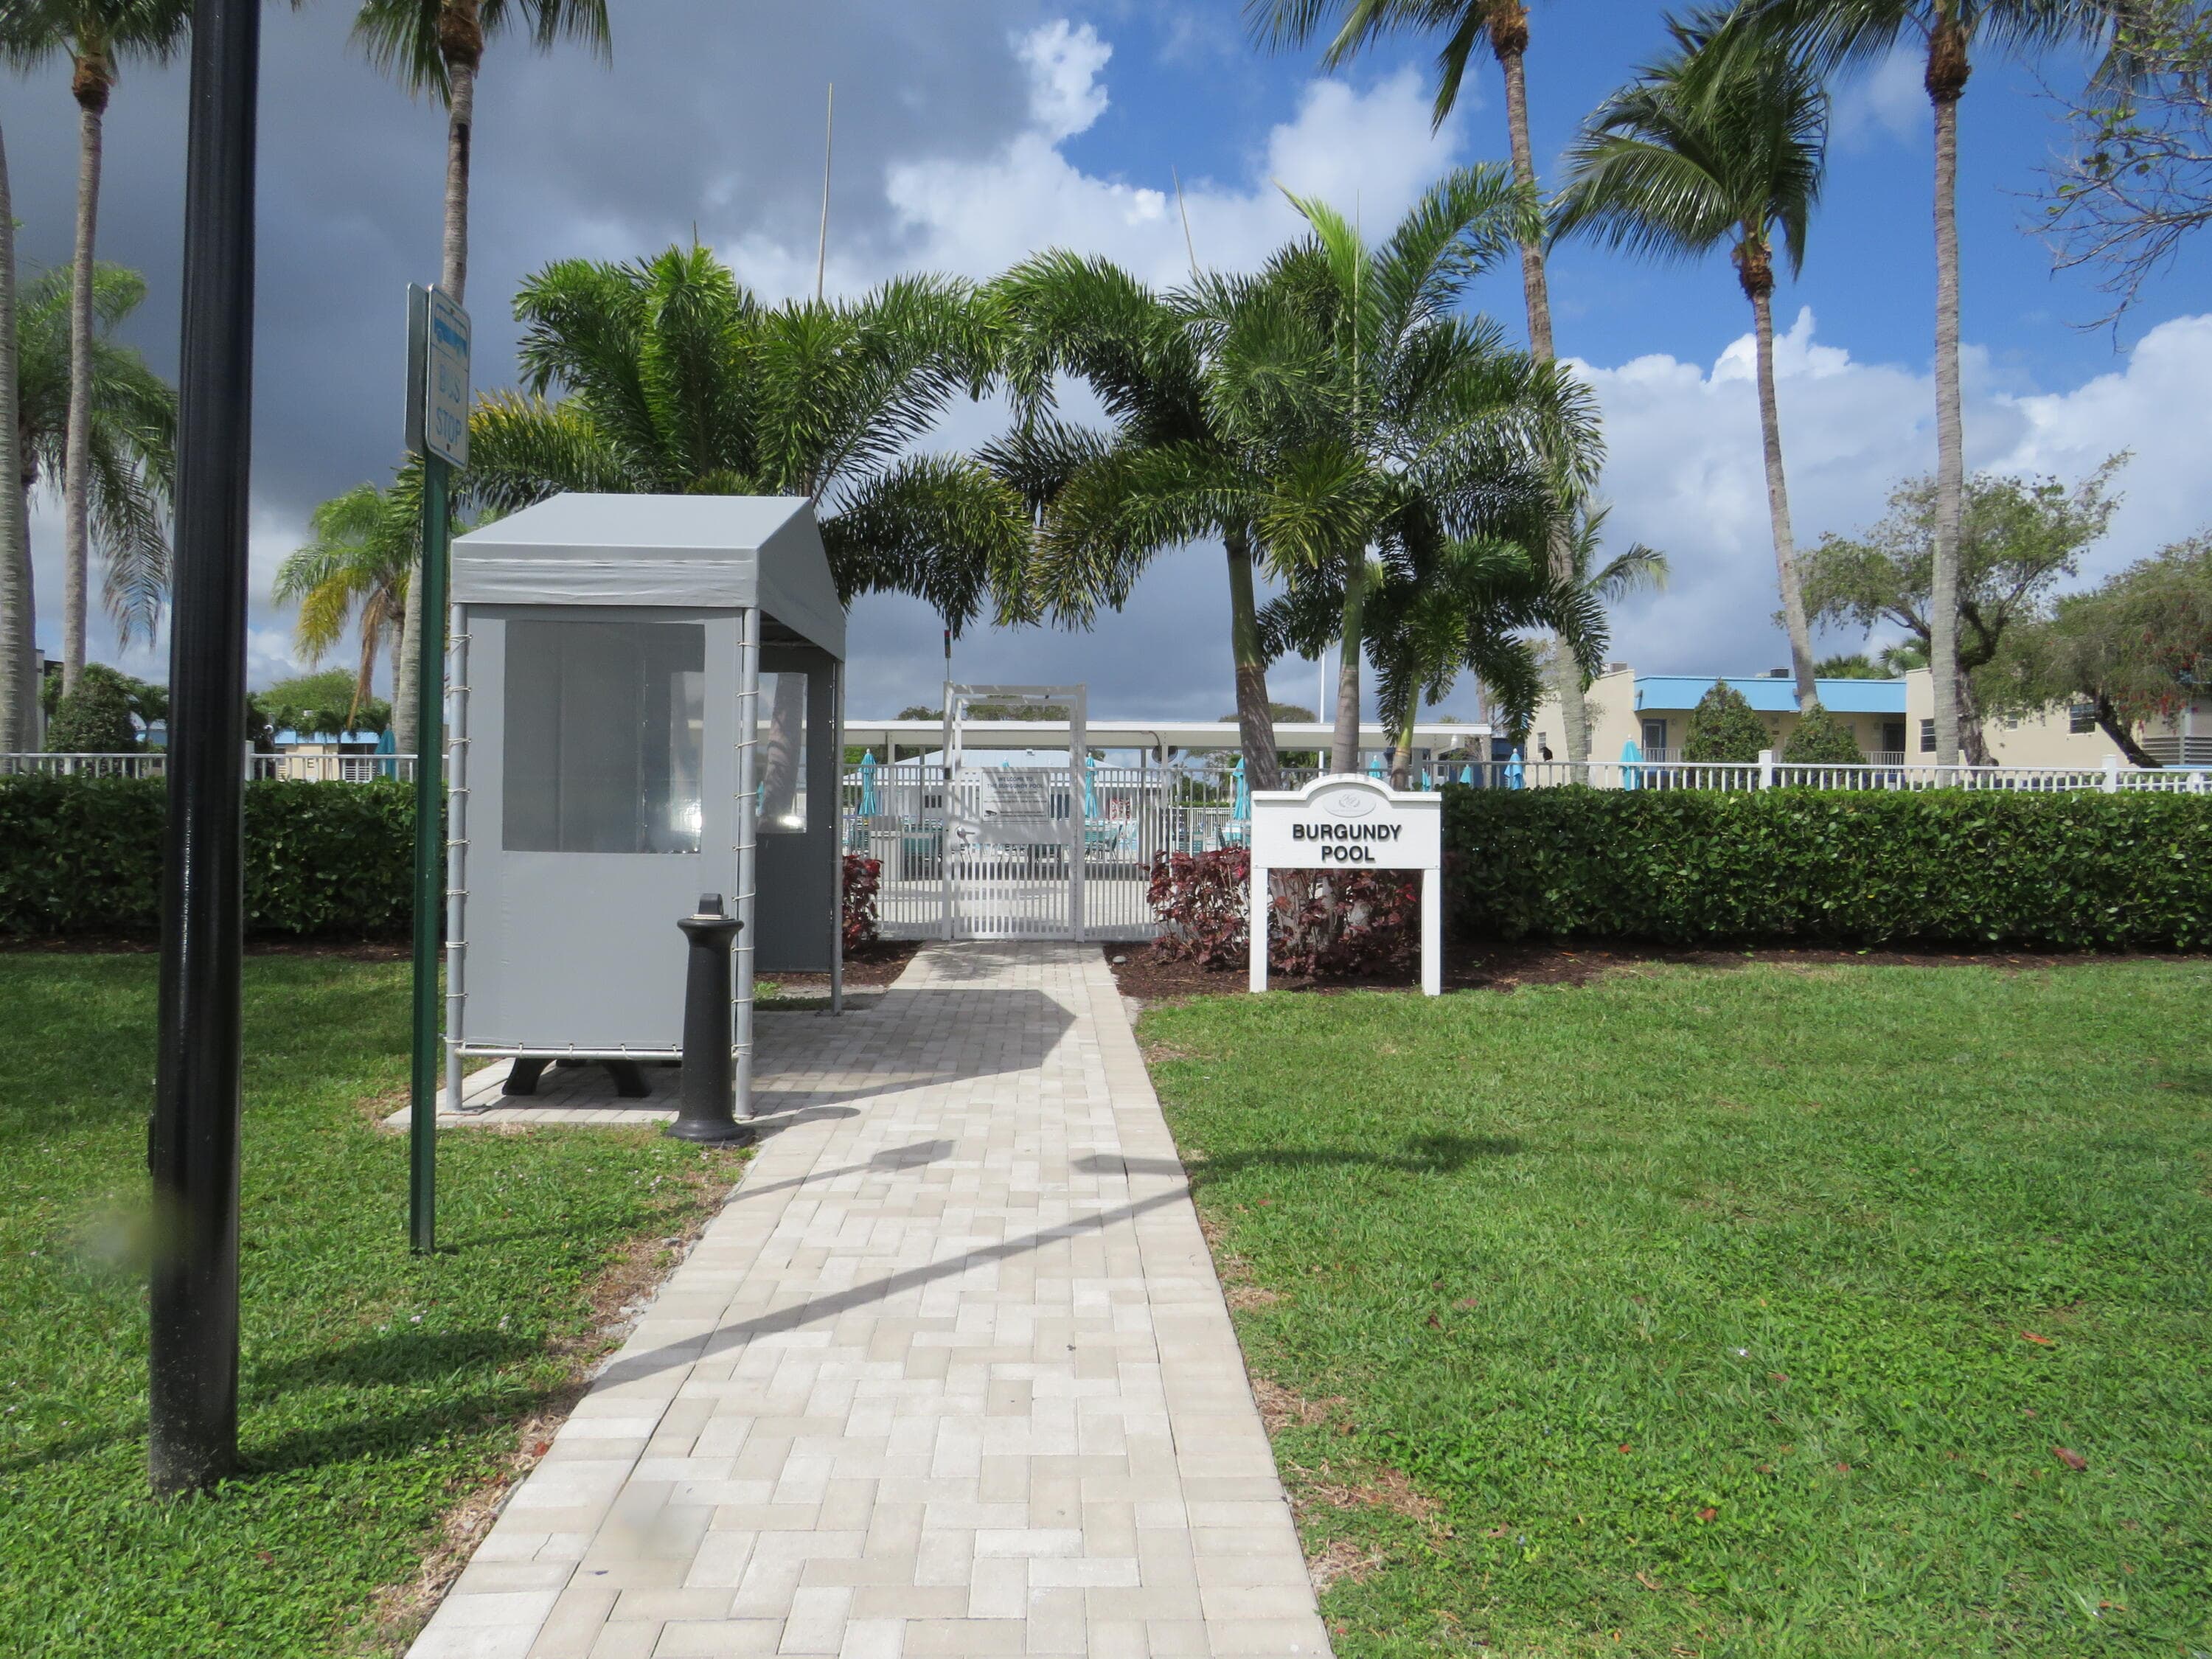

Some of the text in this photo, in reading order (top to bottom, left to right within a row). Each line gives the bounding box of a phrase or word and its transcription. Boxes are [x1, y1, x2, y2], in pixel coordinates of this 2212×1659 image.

[437, 406, 461, 445] STOP
[307, 758, 315, 768] E
[1293, 824, 1402, 840] BURGUNDY
[1321, 846, 1375, 861] POOL
